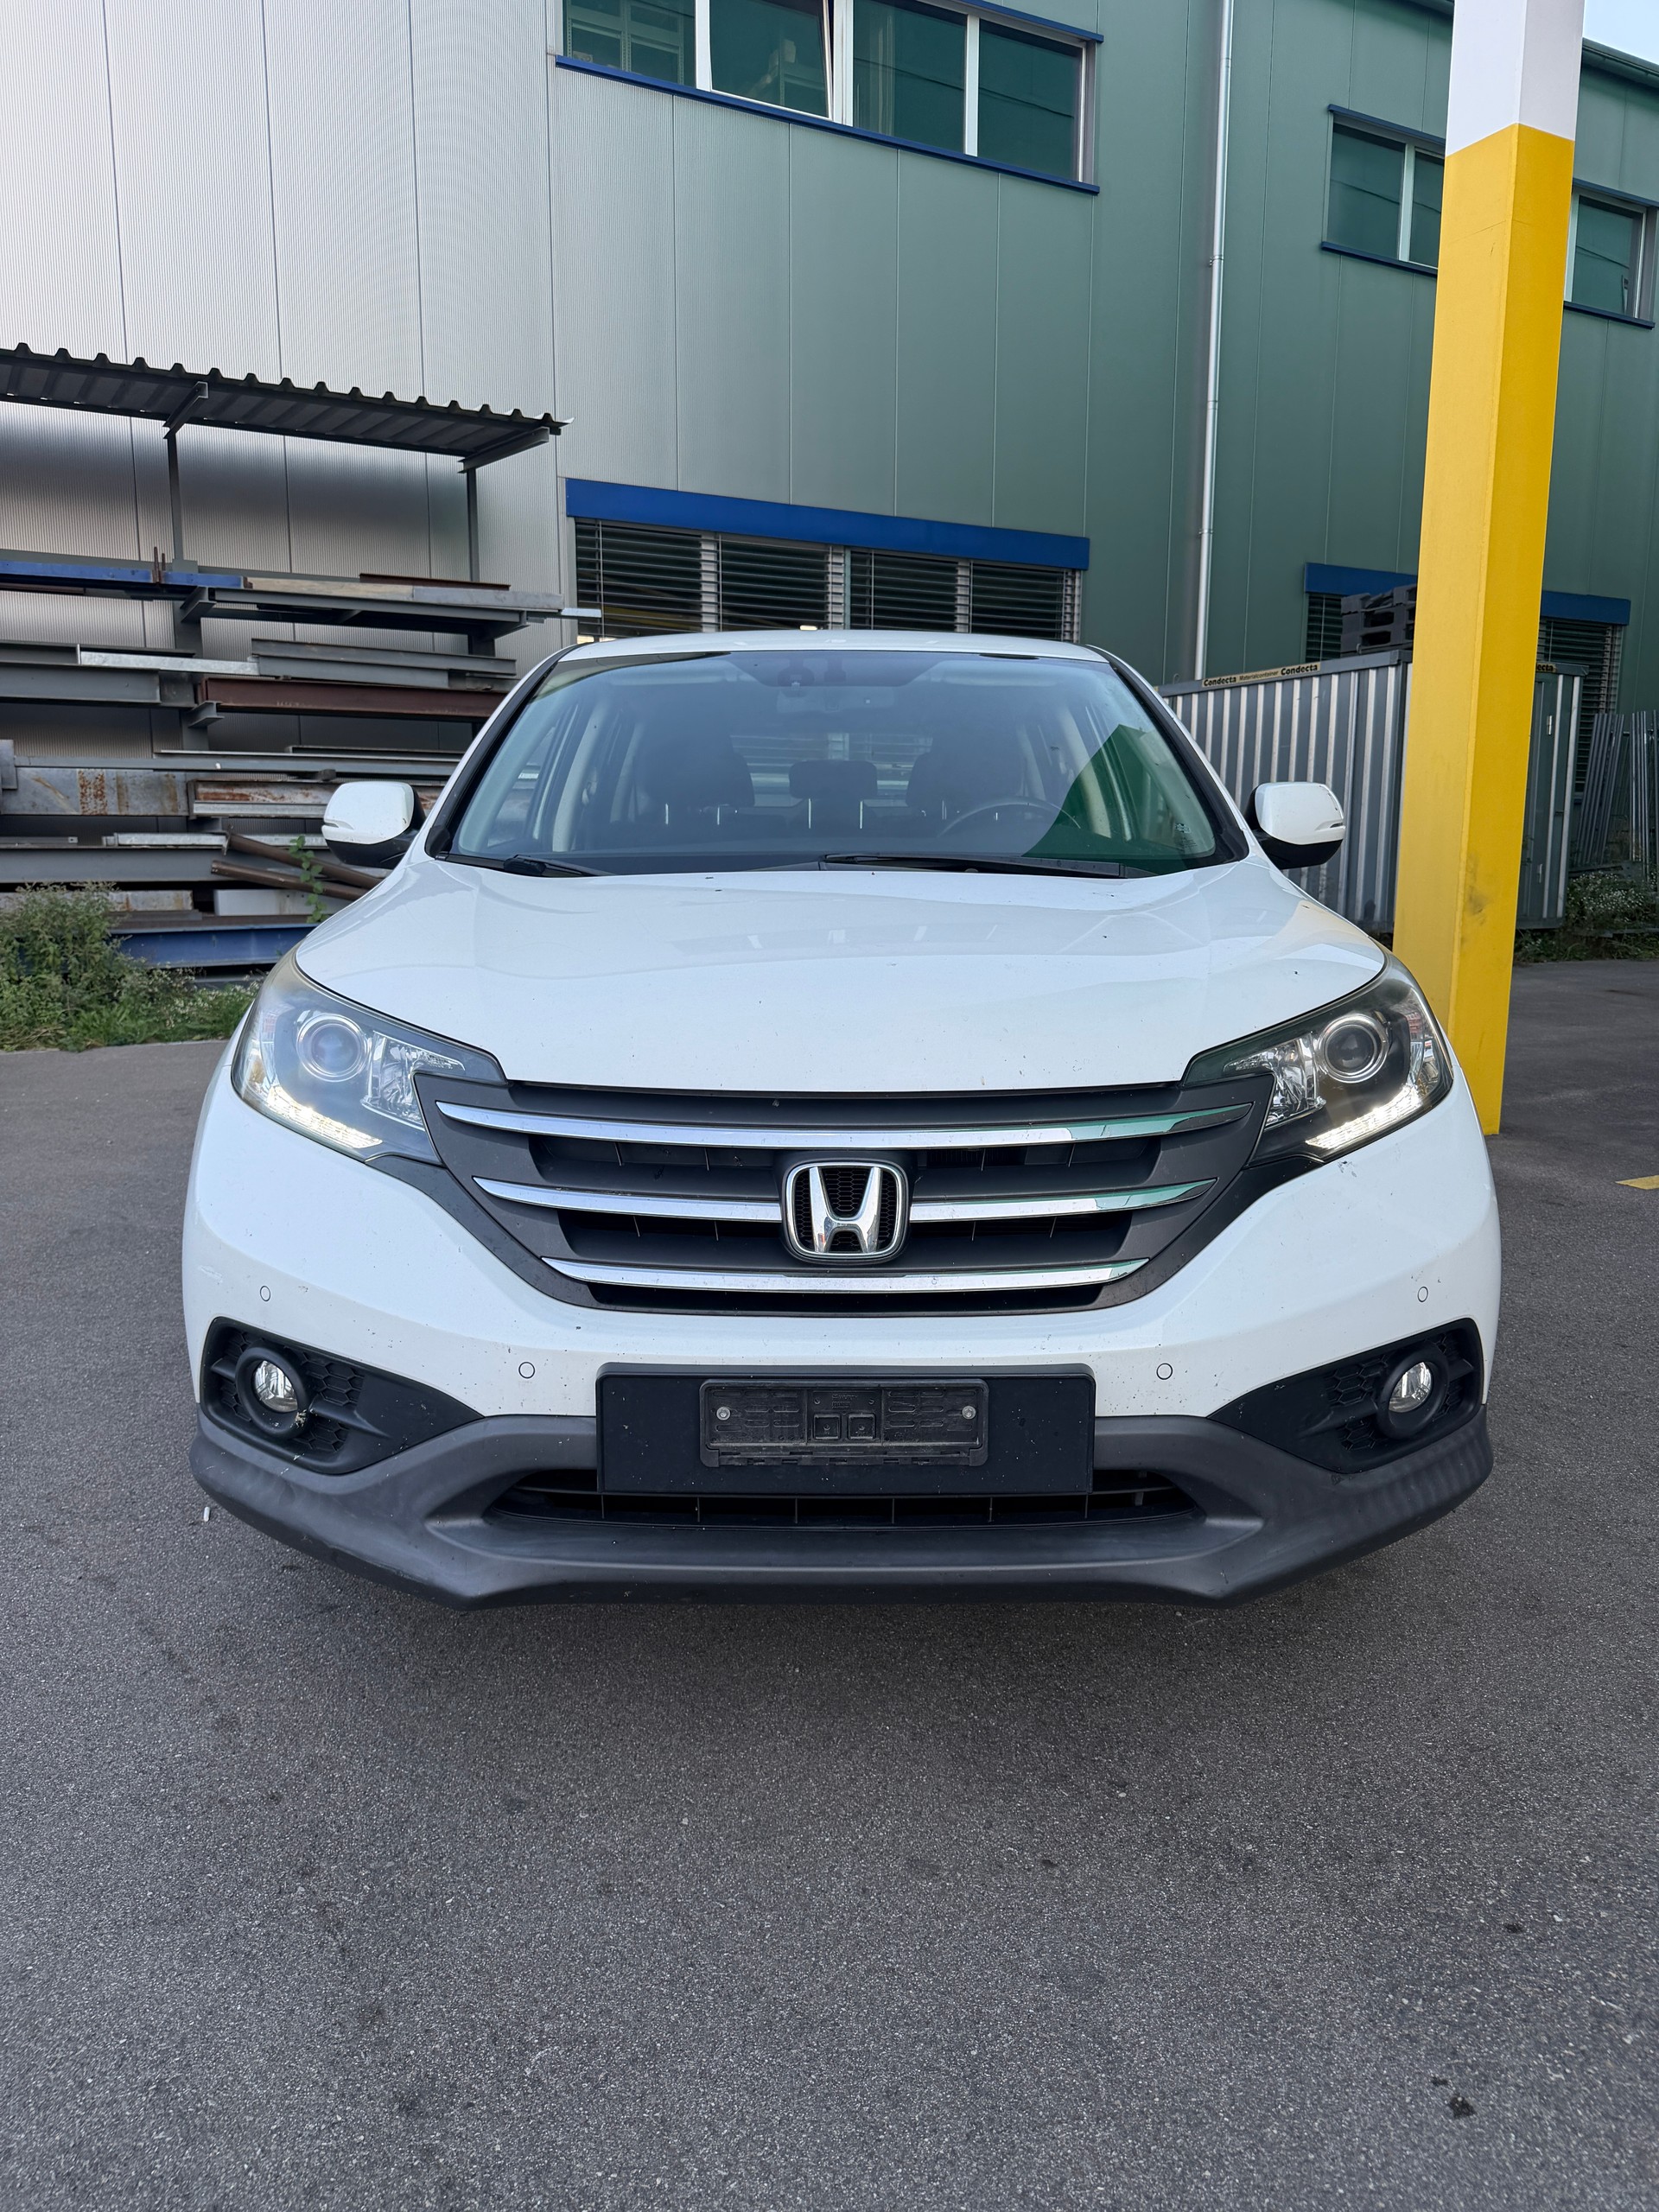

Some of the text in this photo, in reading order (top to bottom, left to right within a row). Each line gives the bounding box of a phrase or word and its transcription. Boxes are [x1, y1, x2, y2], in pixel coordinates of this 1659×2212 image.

[1204, 677, 1236, 686] Condecta
[1281, 664, 1318, 676] Condecta
[1535, 664, 1554, 672] ecta
